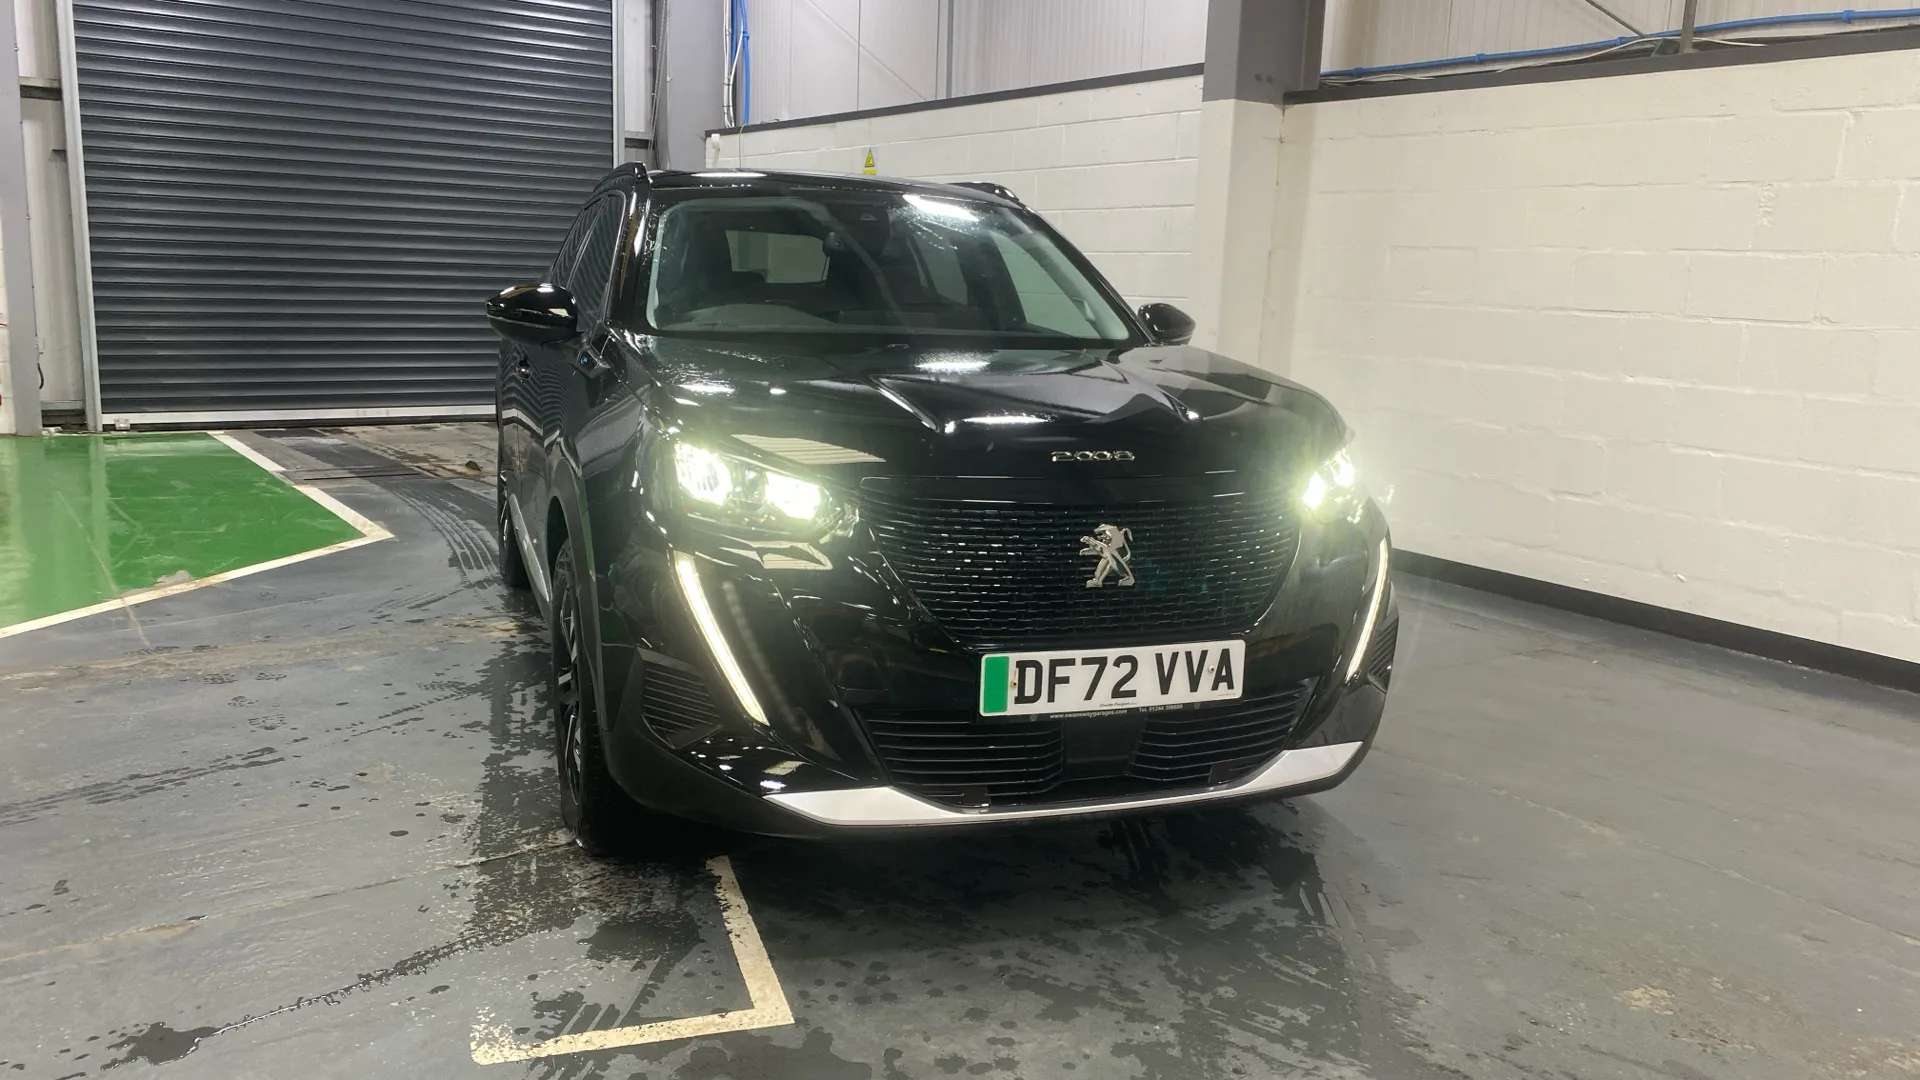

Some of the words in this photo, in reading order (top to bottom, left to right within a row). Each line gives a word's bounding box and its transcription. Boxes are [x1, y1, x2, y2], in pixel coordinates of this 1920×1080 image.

[1050, 450, 1135, 462] 2008
[1014, 654, 1139, 704] DF72
[1155, 648, 1235, 695] VVA
